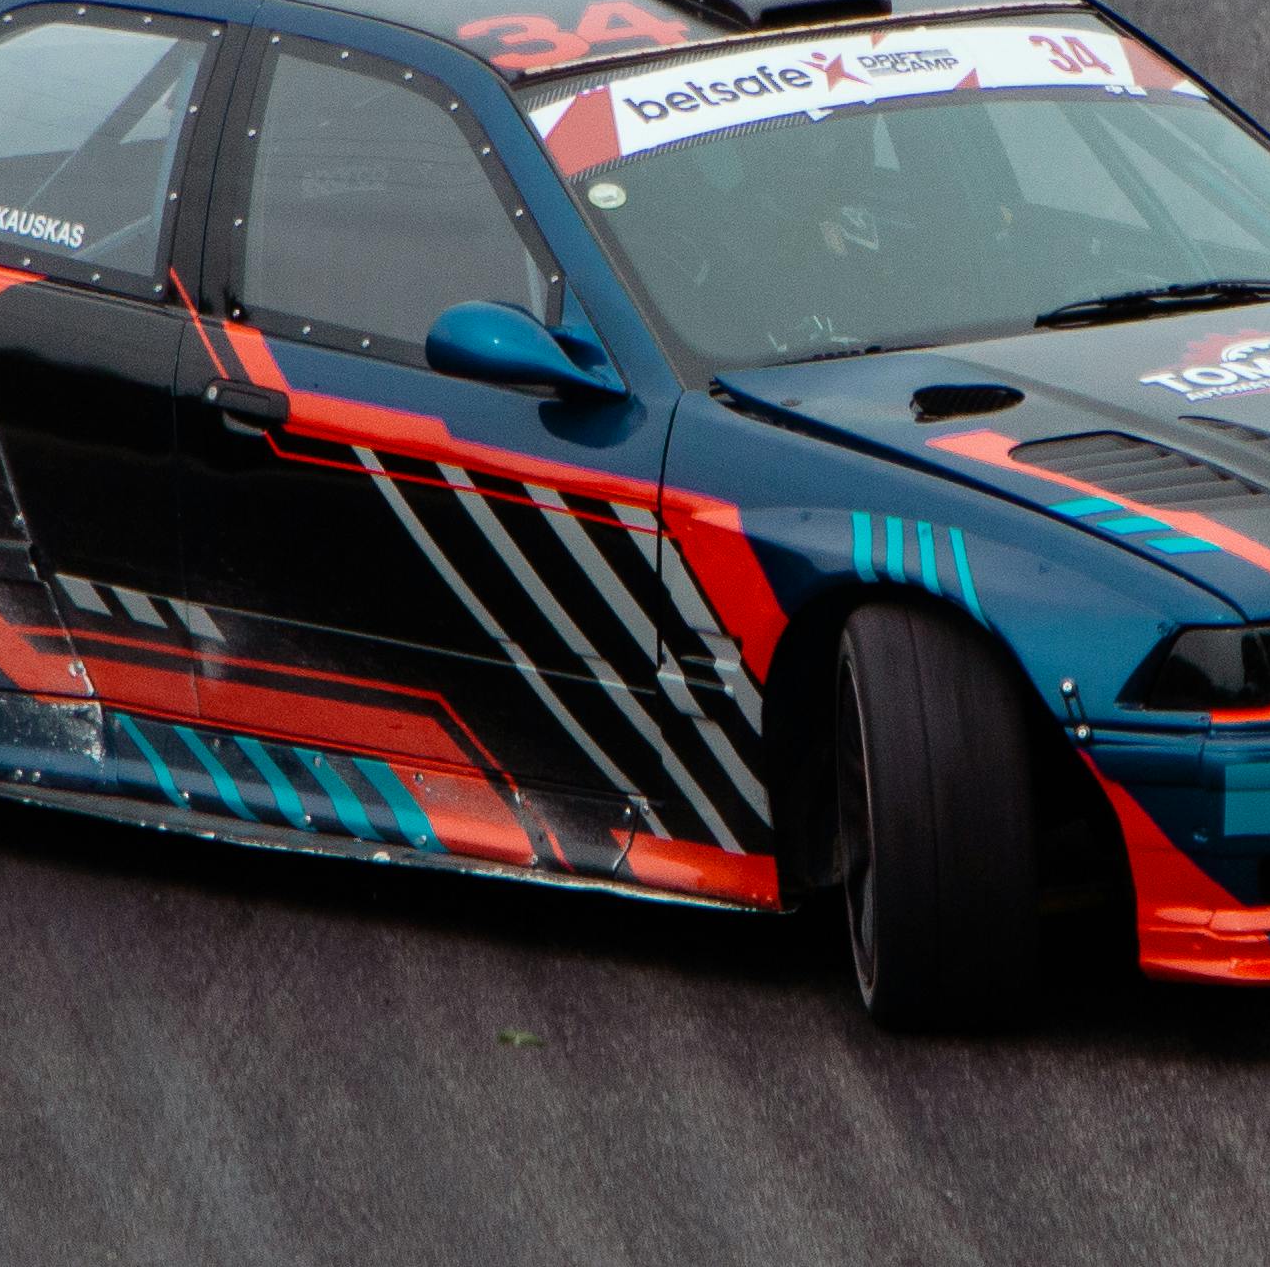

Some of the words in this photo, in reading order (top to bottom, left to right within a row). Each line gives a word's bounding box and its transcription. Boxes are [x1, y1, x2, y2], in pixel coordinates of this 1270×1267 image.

[457, 0, 689, 69] 34
[1029, 35, 1115, 75] 34
[891, 57, 959, 73] CAMP
[623, 64, 814, 124] betsafe
